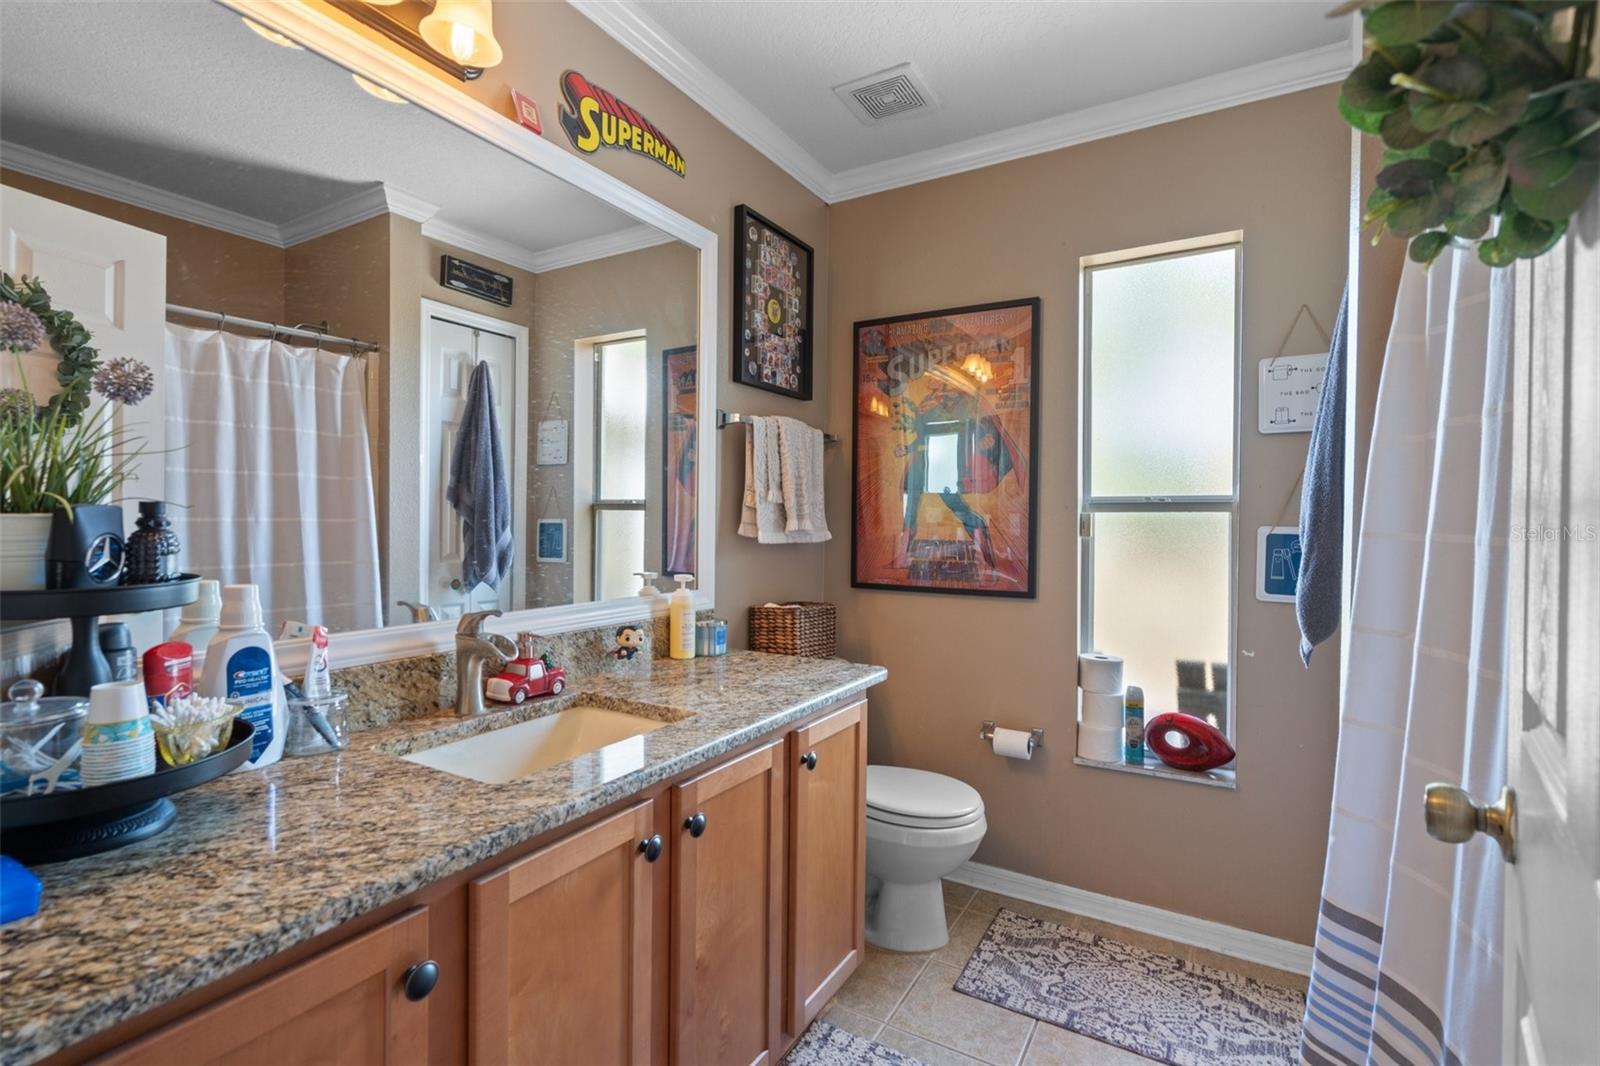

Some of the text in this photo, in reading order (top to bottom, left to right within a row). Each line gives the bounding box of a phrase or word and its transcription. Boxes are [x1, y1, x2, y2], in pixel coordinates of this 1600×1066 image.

[578, 96, 685, 175] SUPERMAN
[888, 339, 1012, 395] SUPERMAN
[1008, 346, 1029, 384] 1
